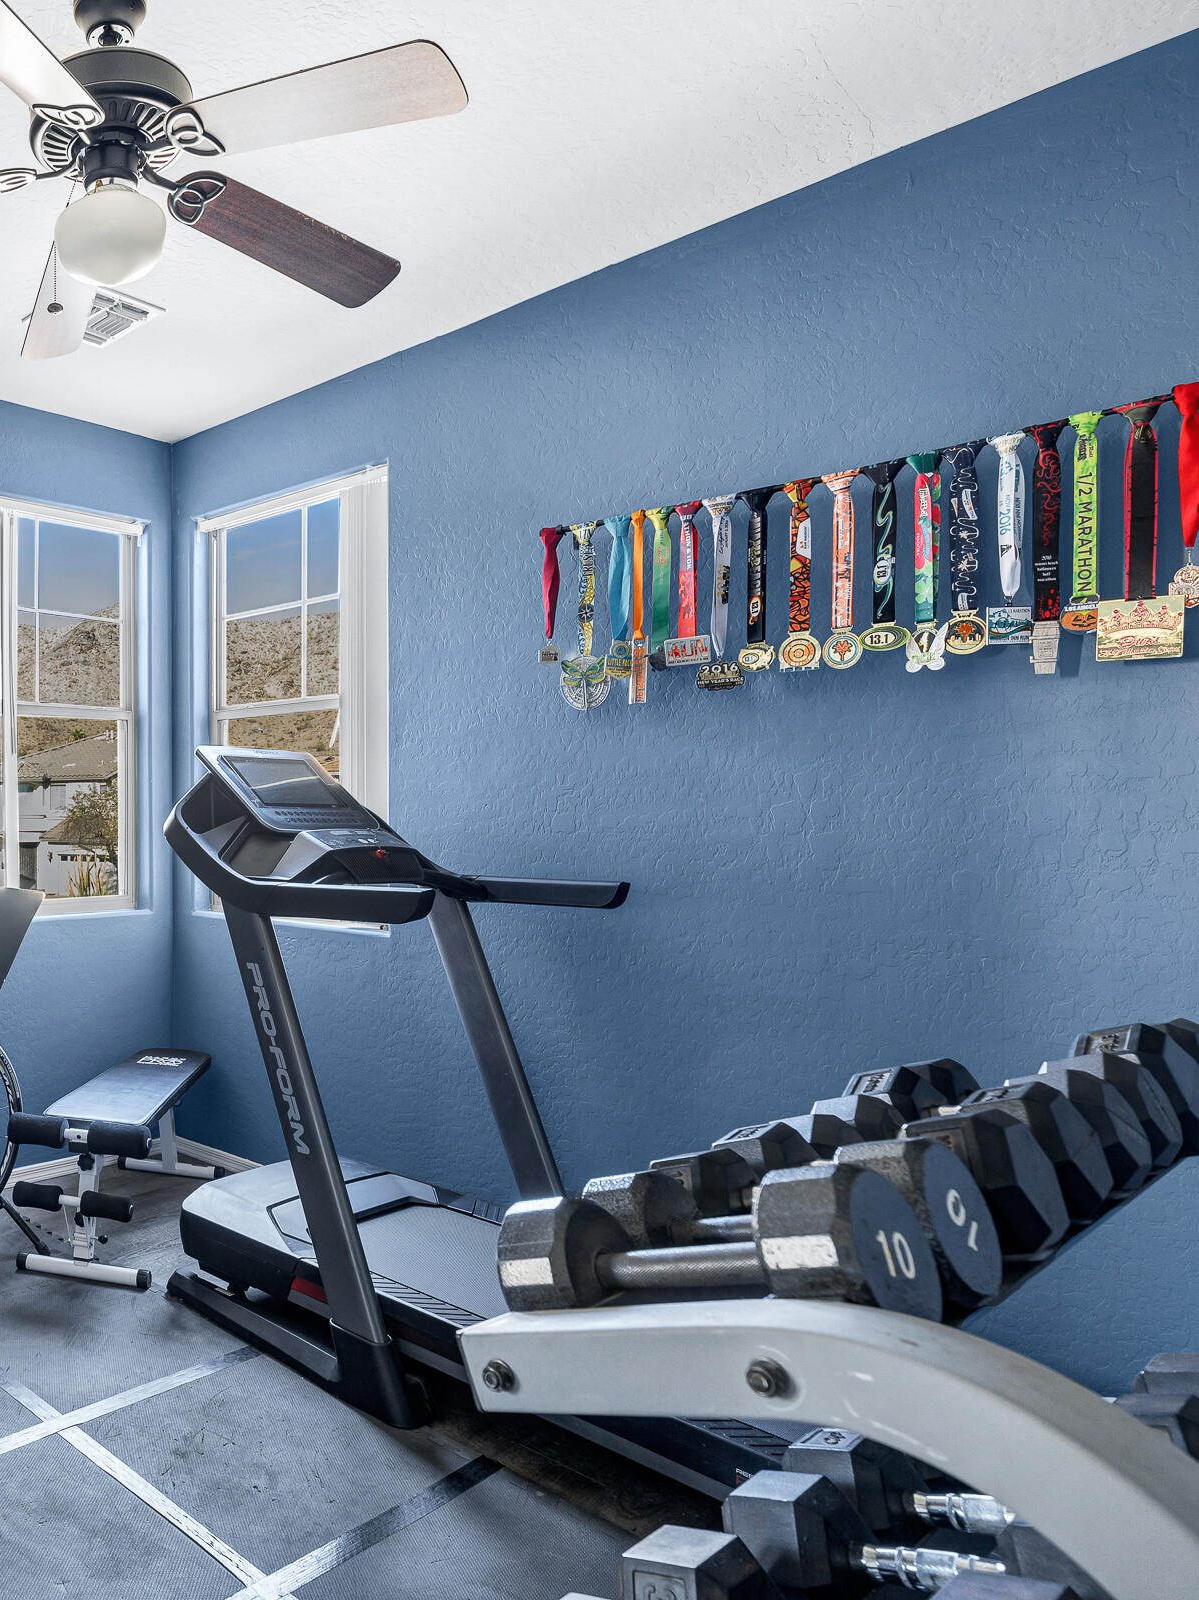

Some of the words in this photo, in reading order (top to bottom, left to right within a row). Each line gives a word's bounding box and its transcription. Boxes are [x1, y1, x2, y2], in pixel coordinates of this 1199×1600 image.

[1076, 472, 1094, 497] 1/2
[999, 508, 1011, 535] 2016
[1077, 501, 1093, 593] MARATHON
[876, 564, 889, 578] 13.1
[751, 600, 759, 614] 13.1
[869, 633, 890, 645] 13.1
[701, 662, 739, 675] 2016
[246, 961, 311, 1157] PRO-FORM
[945, 1188, 979, 1252] 10
[875, 1229, 917, 1280] 10
